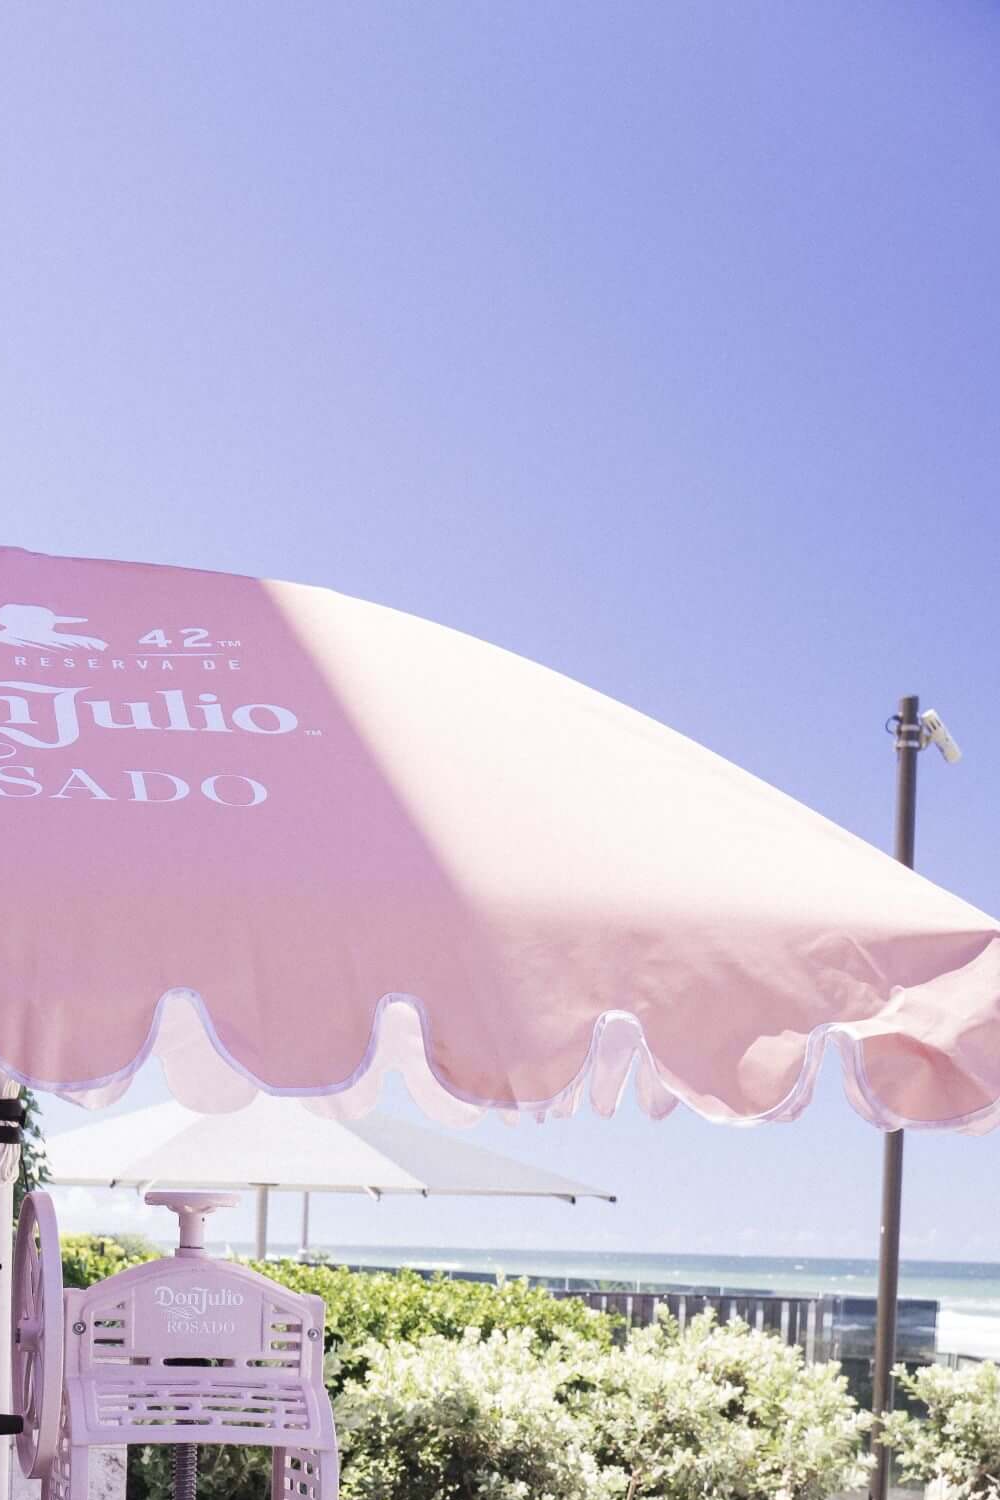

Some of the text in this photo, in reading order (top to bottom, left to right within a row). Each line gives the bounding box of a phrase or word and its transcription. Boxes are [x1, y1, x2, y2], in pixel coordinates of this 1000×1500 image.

[137, 628, 212, 648] 42
[14, 655, 174, 671] RESERVA
[203, 659, 241, 671] DE
[167, 1320, 236, 1335] ROSADO
